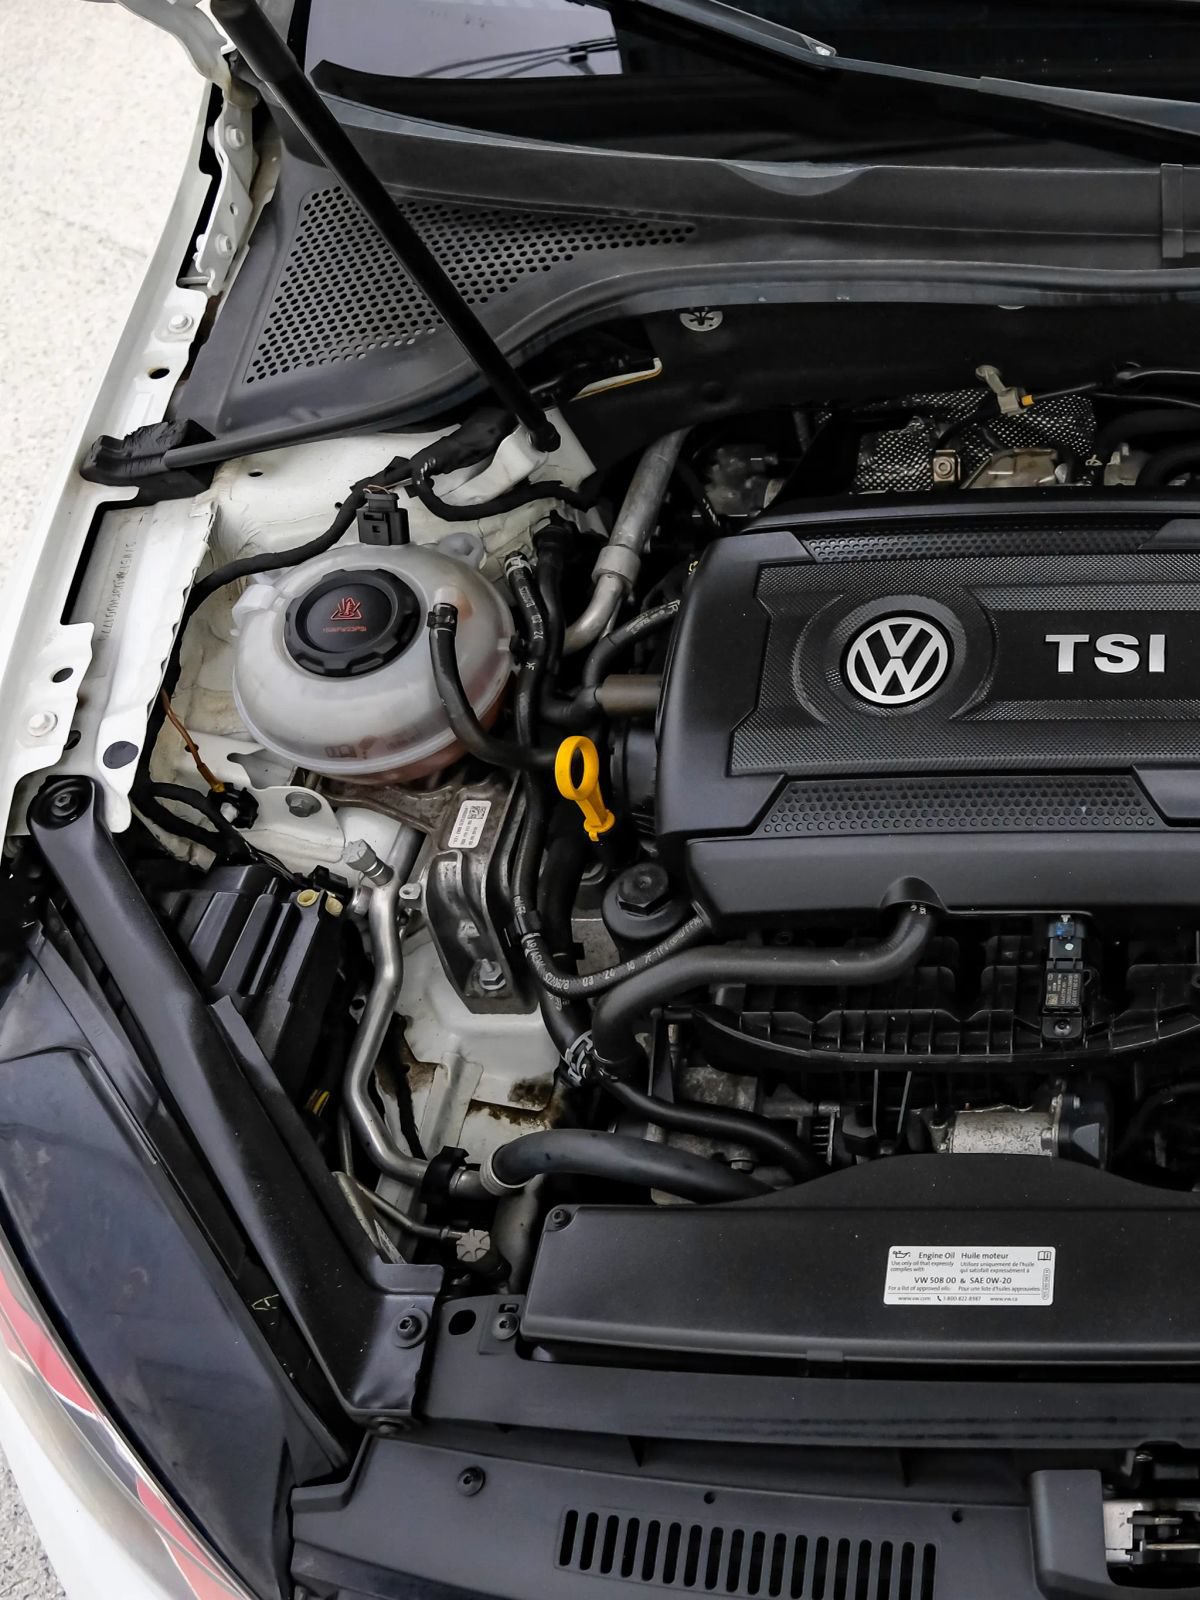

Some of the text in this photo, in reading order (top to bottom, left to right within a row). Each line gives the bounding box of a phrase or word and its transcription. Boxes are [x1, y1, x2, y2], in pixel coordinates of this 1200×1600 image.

[846, 617, 949, 705] VW
[1045, 633, 1166, 673] TSI
[919, 1252, 943, 1260] Engine
[914, 1276, 928, 1284] VW
[930, 1276, 945, 1284] 508
[945, 1276, 957, 1284] 00
